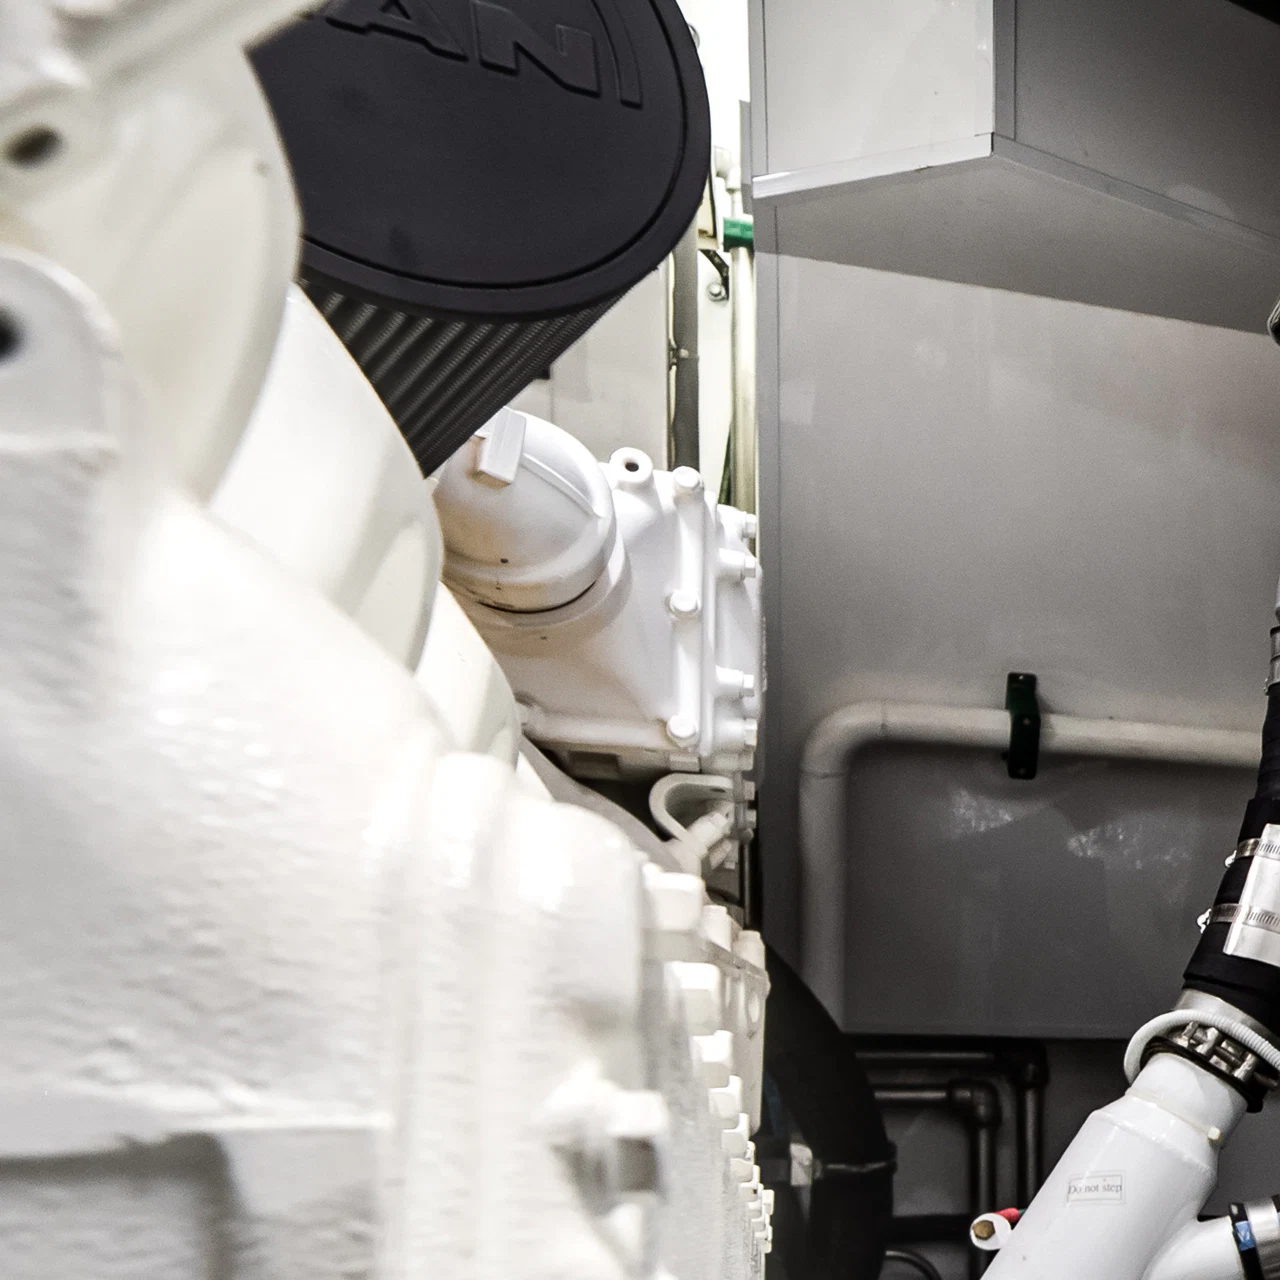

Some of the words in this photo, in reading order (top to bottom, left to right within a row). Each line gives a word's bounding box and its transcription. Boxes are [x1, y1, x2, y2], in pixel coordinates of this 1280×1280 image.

[1068, 1185, 1082, 1195] Do
[1085, 1184, 1099, 1193] not
[1102, 1184, 1122, 1194] step
